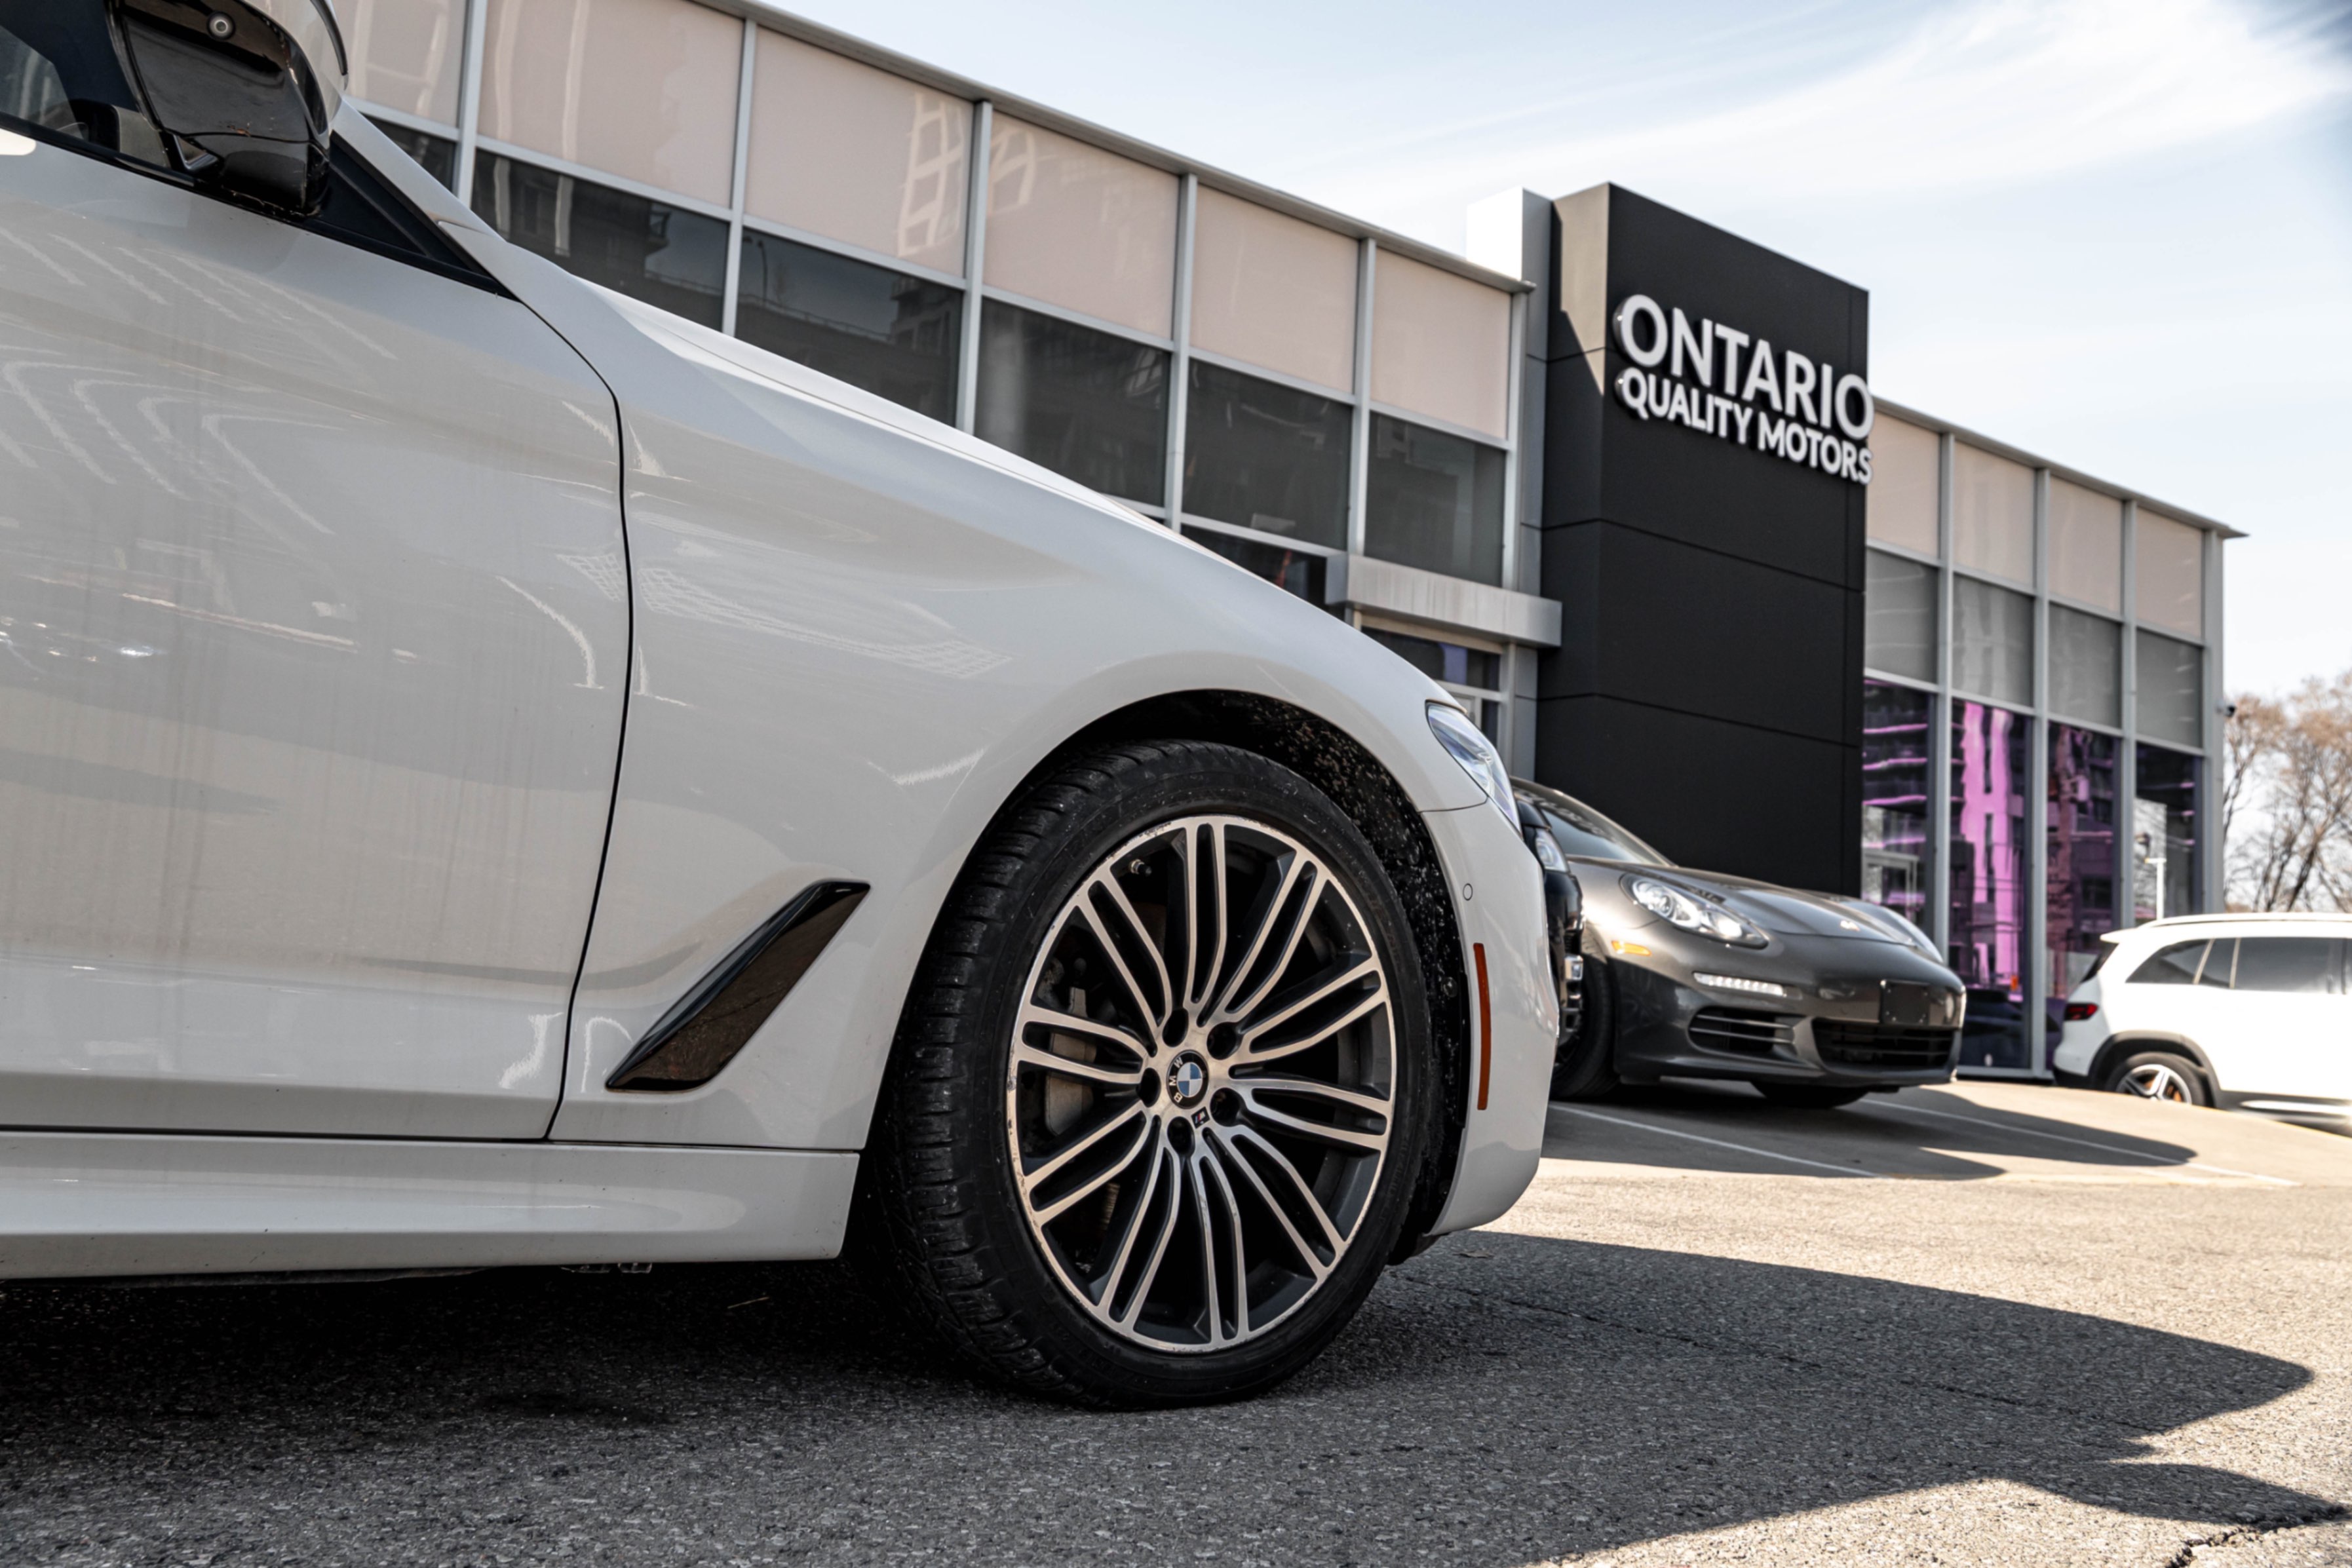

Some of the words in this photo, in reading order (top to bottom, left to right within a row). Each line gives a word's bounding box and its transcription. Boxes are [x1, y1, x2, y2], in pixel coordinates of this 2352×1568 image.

[1614, 294, 1874, 440] ONTARIO
[1617, 367, 1752, 444] QUALITY
[1758, 411, 1873, 485] MOTORS
[1169, 1057, 1184, 1103] BMW
